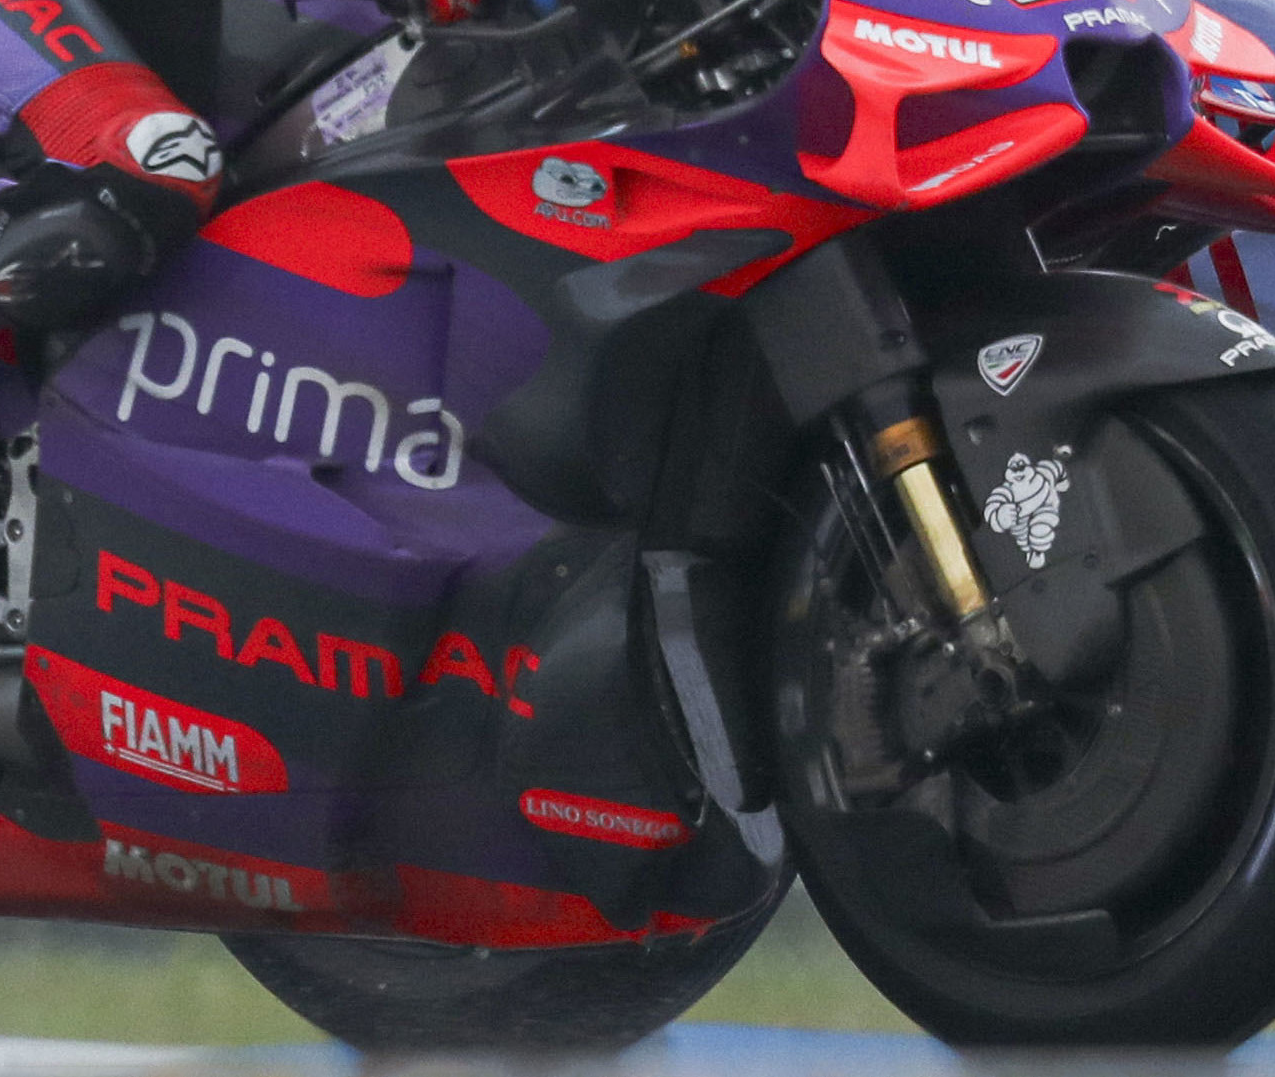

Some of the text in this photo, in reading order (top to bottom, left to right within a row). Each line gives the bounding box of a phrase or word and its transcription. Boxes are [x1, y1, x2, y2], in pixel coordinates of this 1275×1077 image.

[853, 19, 1003, 70] MOTUL
[118, 312, 464, 491] prima
[96, 549, 540, 719] PRAMAC
[100, 691, 238, 783] FIAMM
[526, 797, 581, 823] LINO
[103, 840, 305, 912] MOTUL
